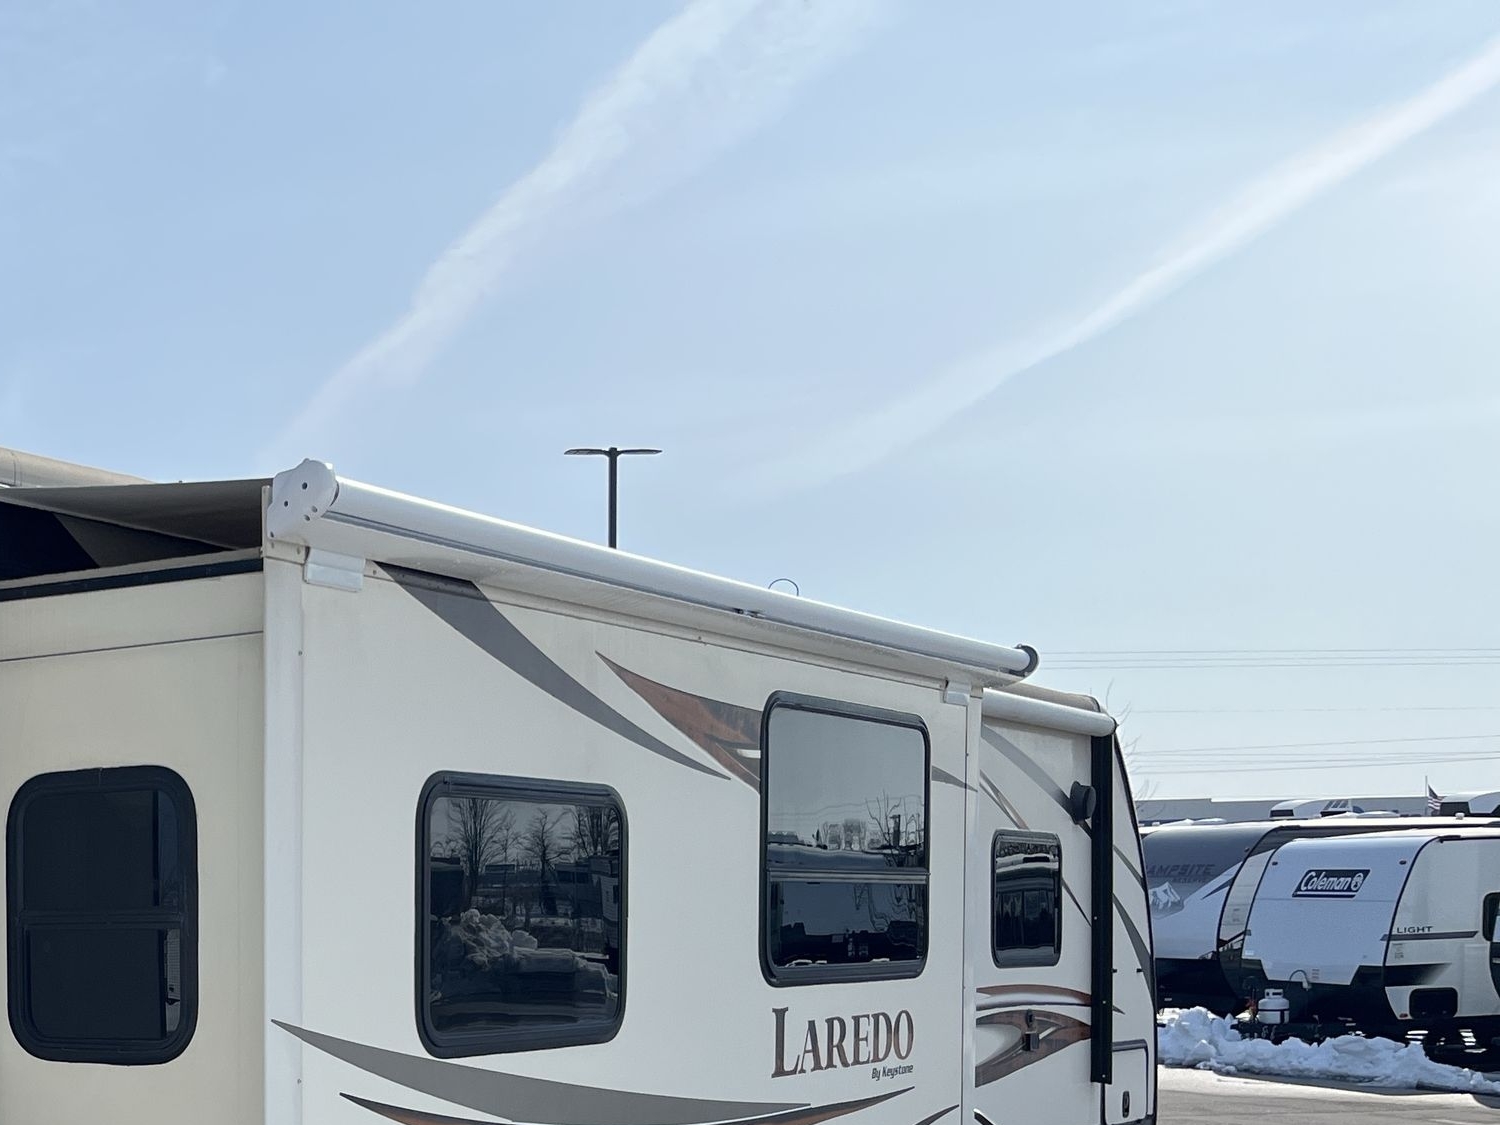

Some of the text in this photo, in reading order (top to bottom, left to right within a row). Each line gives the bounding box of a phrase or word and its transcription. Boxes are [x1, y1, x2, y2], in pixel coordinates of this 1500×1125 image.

[1145, 864, 1216, 876] AMPSITE
[1300, 871, 1352, 891] Coleman
[1396, 926, 1433, 934] LIGHT
[771, 1007, 914, 1078] LAREDO
[871, 1064, 914, 1081] By Keystone
